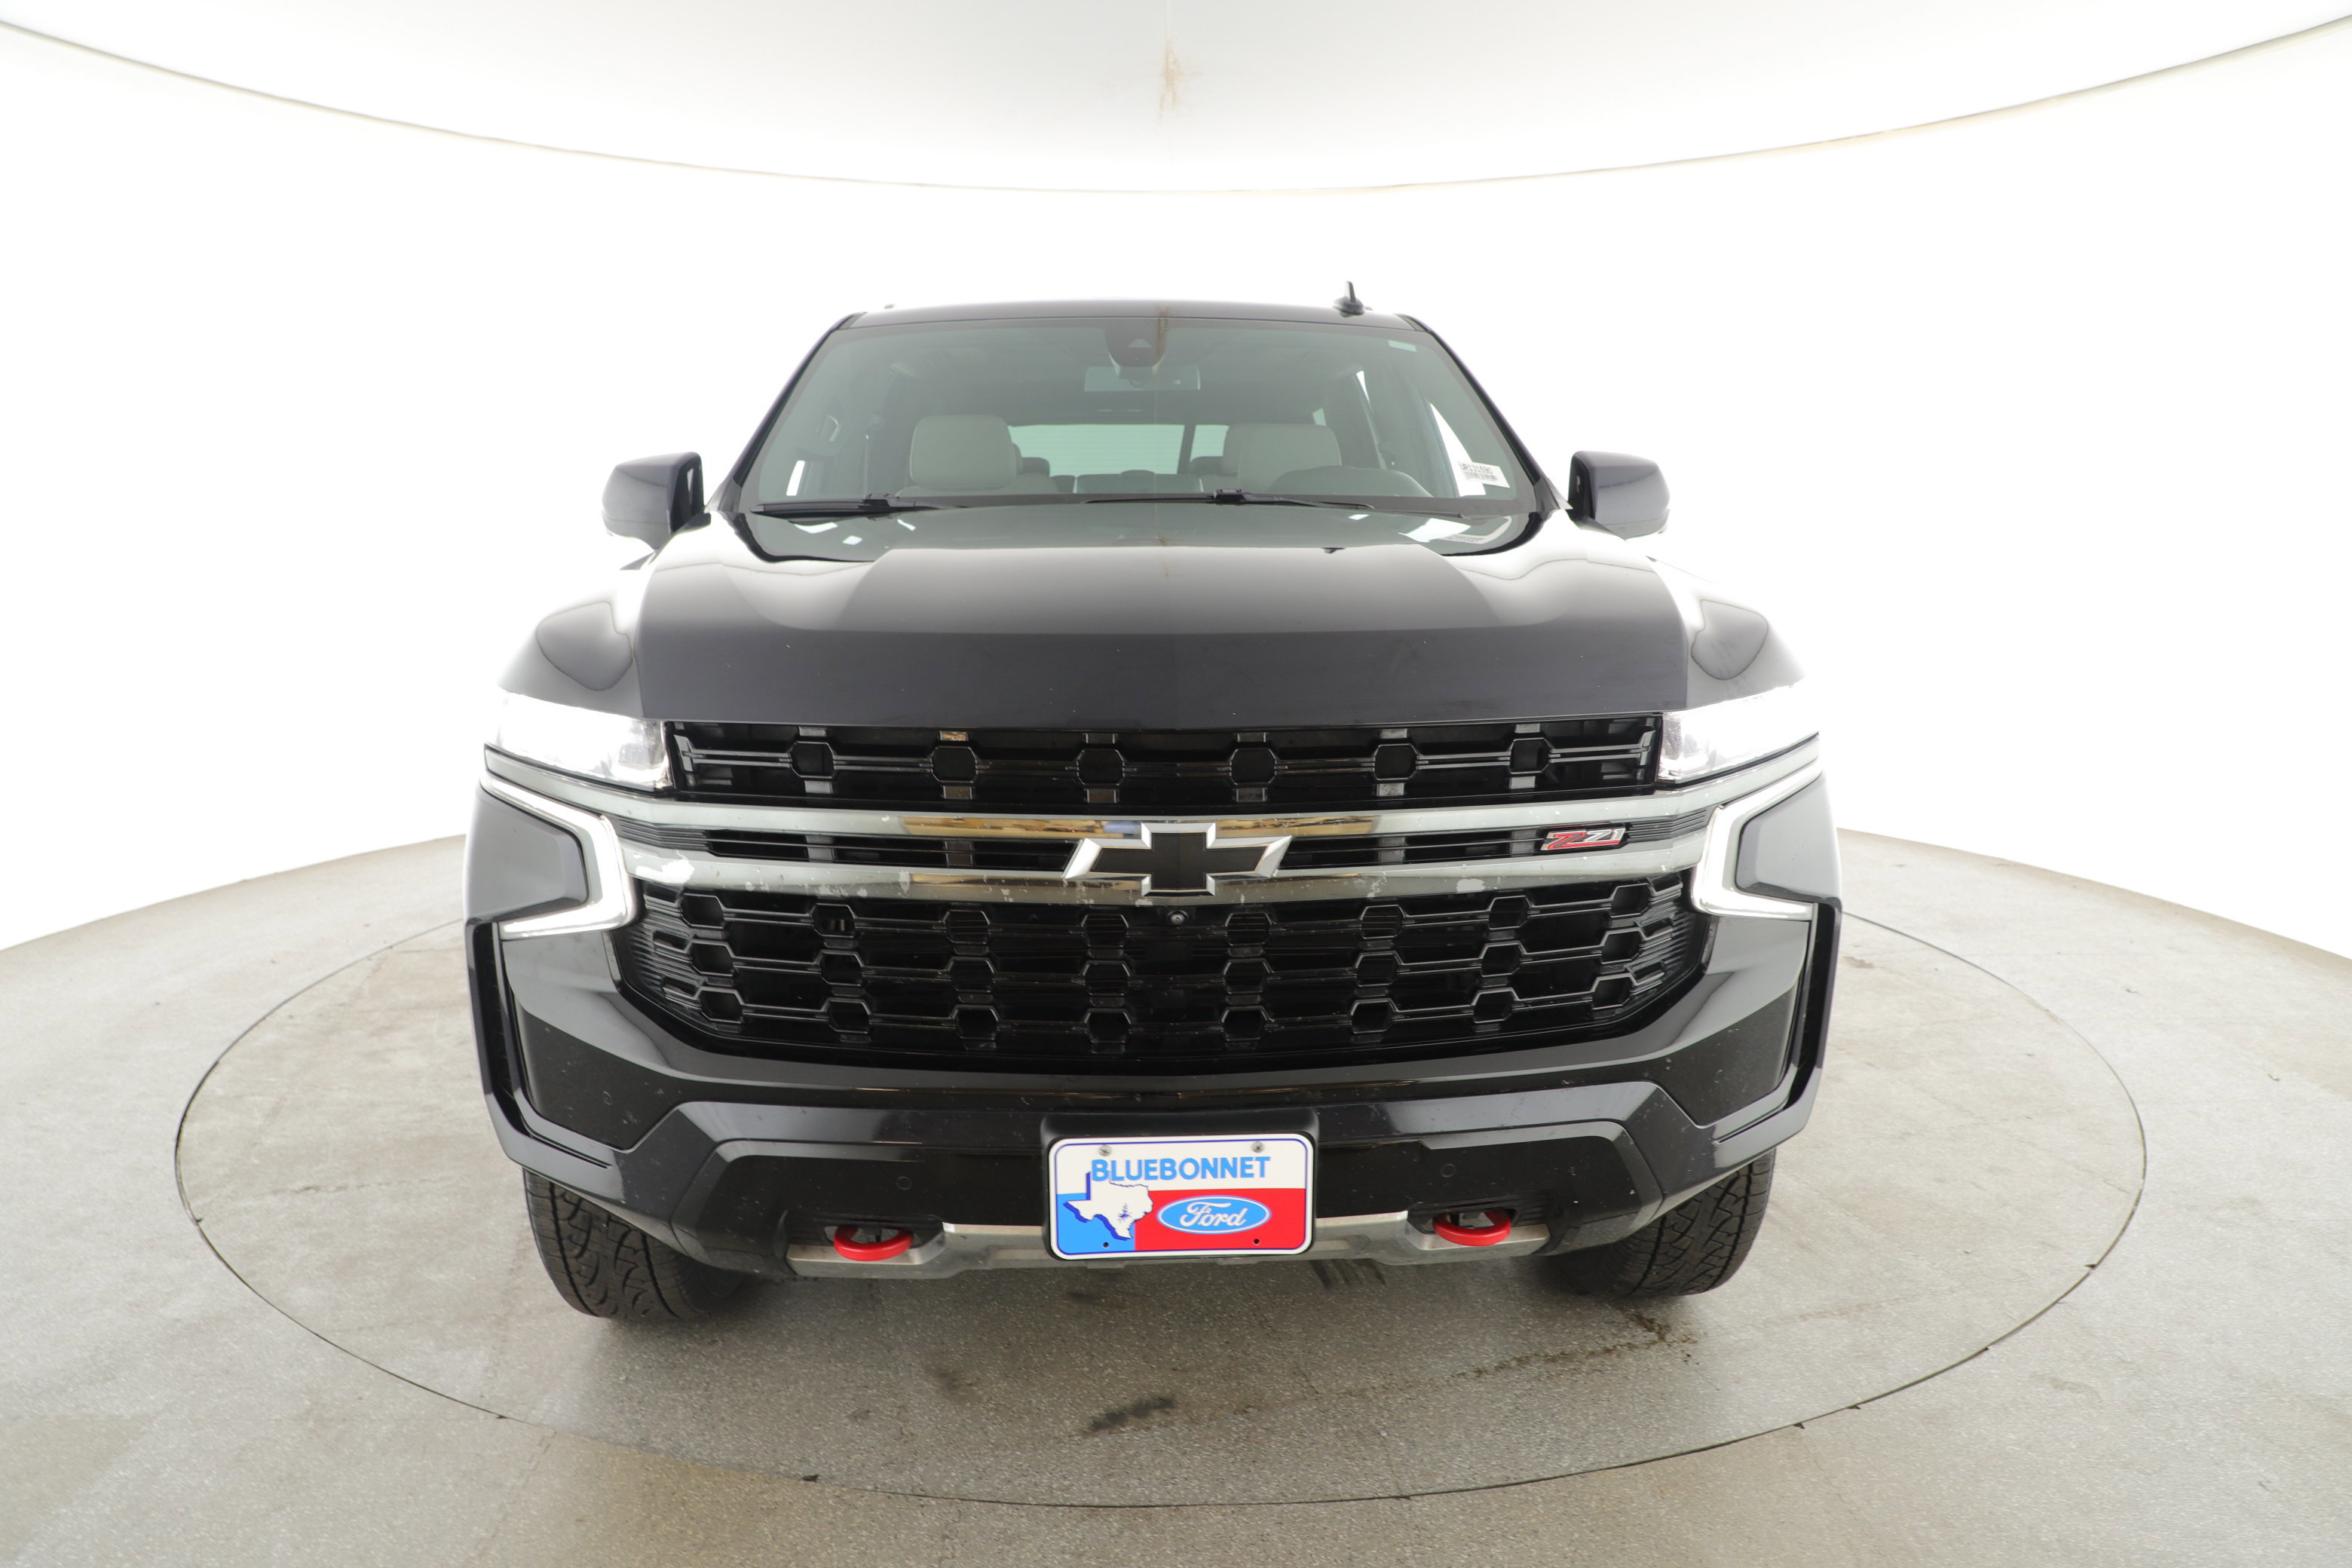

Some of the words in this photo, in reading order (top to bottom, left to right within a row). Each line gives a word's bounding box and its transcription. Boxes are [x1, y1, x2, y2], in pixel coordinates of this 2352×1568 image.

[1540, 828, 1626, 850] Z71
[1092, 1156, 1271, 1181] BLUEBONNET
[1179, 1201, 1249, 1227] Ford
